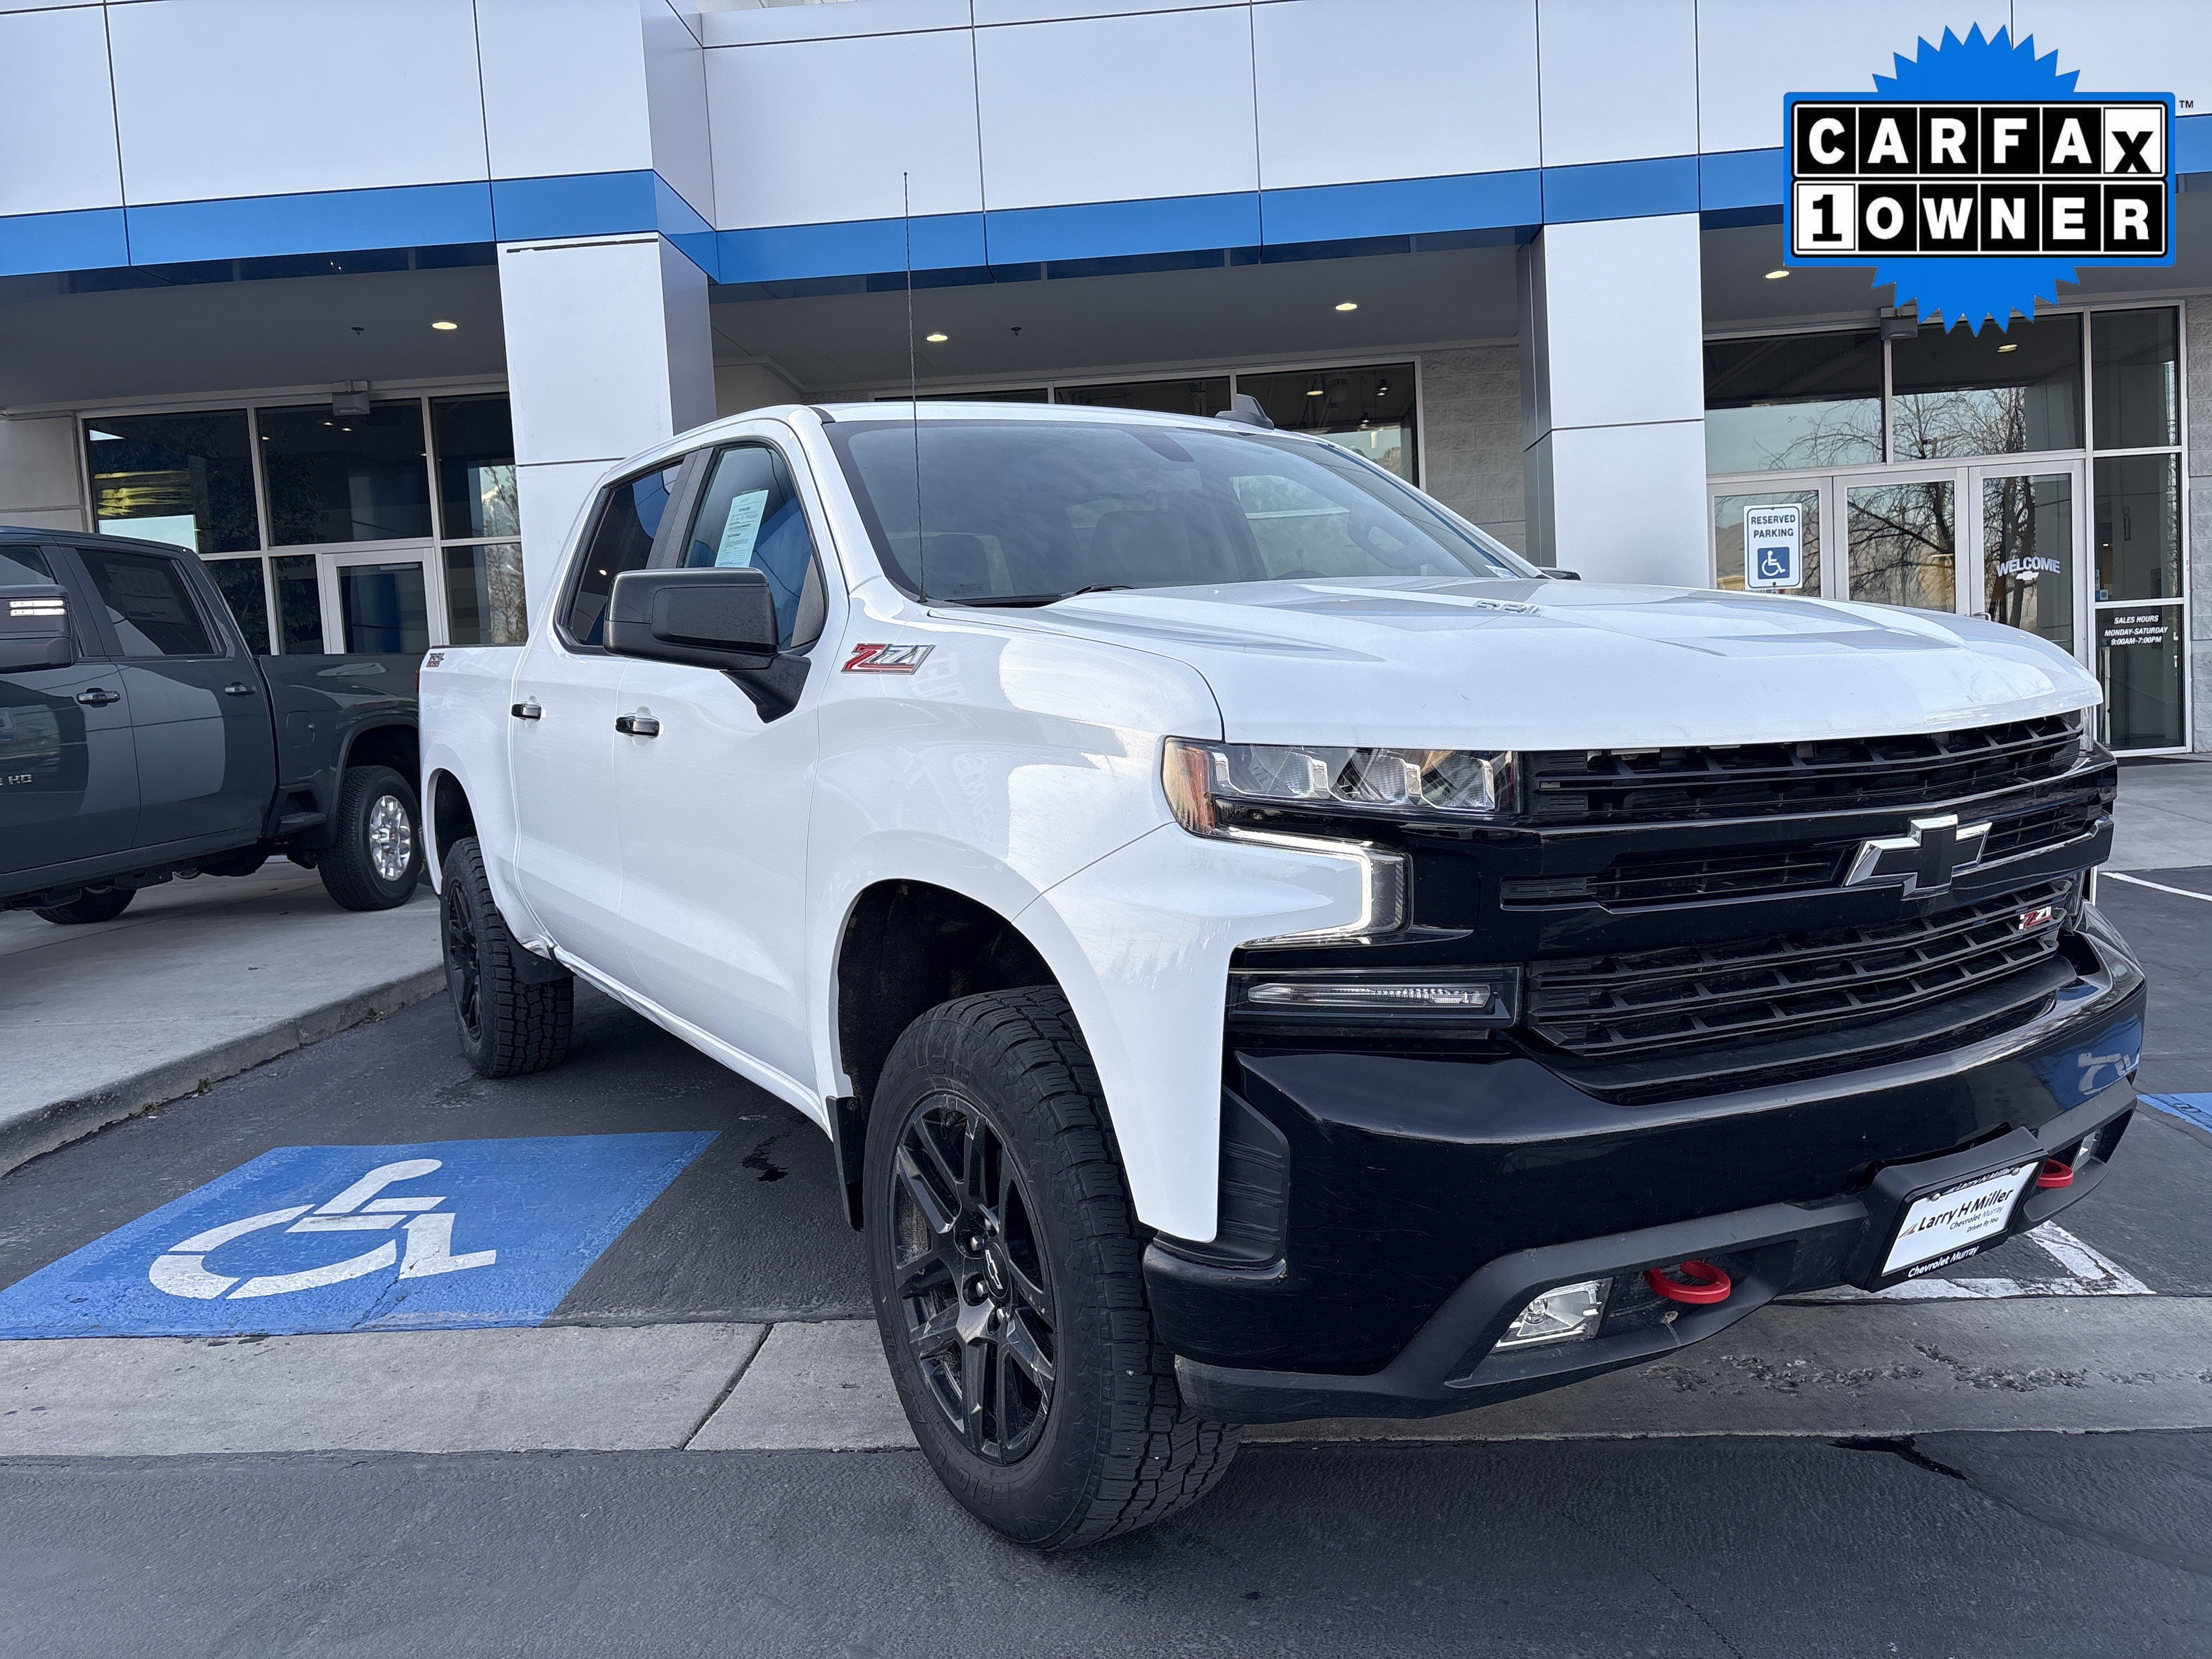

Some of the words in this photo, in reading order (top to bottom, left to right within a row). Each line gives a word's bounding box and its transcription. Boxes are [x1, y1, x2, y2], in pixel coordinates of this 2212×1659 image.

[1751, 515, 1796, 525] RESERVED
[1753, 528, 1794, 538] PARKING
[1996, 556, 2061, 577] WELCOME
[2114, 616, 2135, 624] SALES
[2136, 614, 2159, 623] HOURS
[2104, 626, 2169, 637] MONDAY-SATURDAY
[2111, 636, 2163, 646] 9:00AM-7:00PM
[840, 643, 936, 675] Z71
[8, 774, 32, 785] HD
[2019, 906, 2052, 930] Z71
[1917, 1208, 1959, 1232] Larry
[1957, 1201, 1972, 1217] H
[1970, 1189, 2014, 1213] Miller
[1950, 1214, 1982, 1229] Chevrolet
[1982, 1206, 2004, 1218] Murray
[1908, 1256, 1950, 1278] Chevrolet
[1949, 1245, 1979, 1263] Murray
